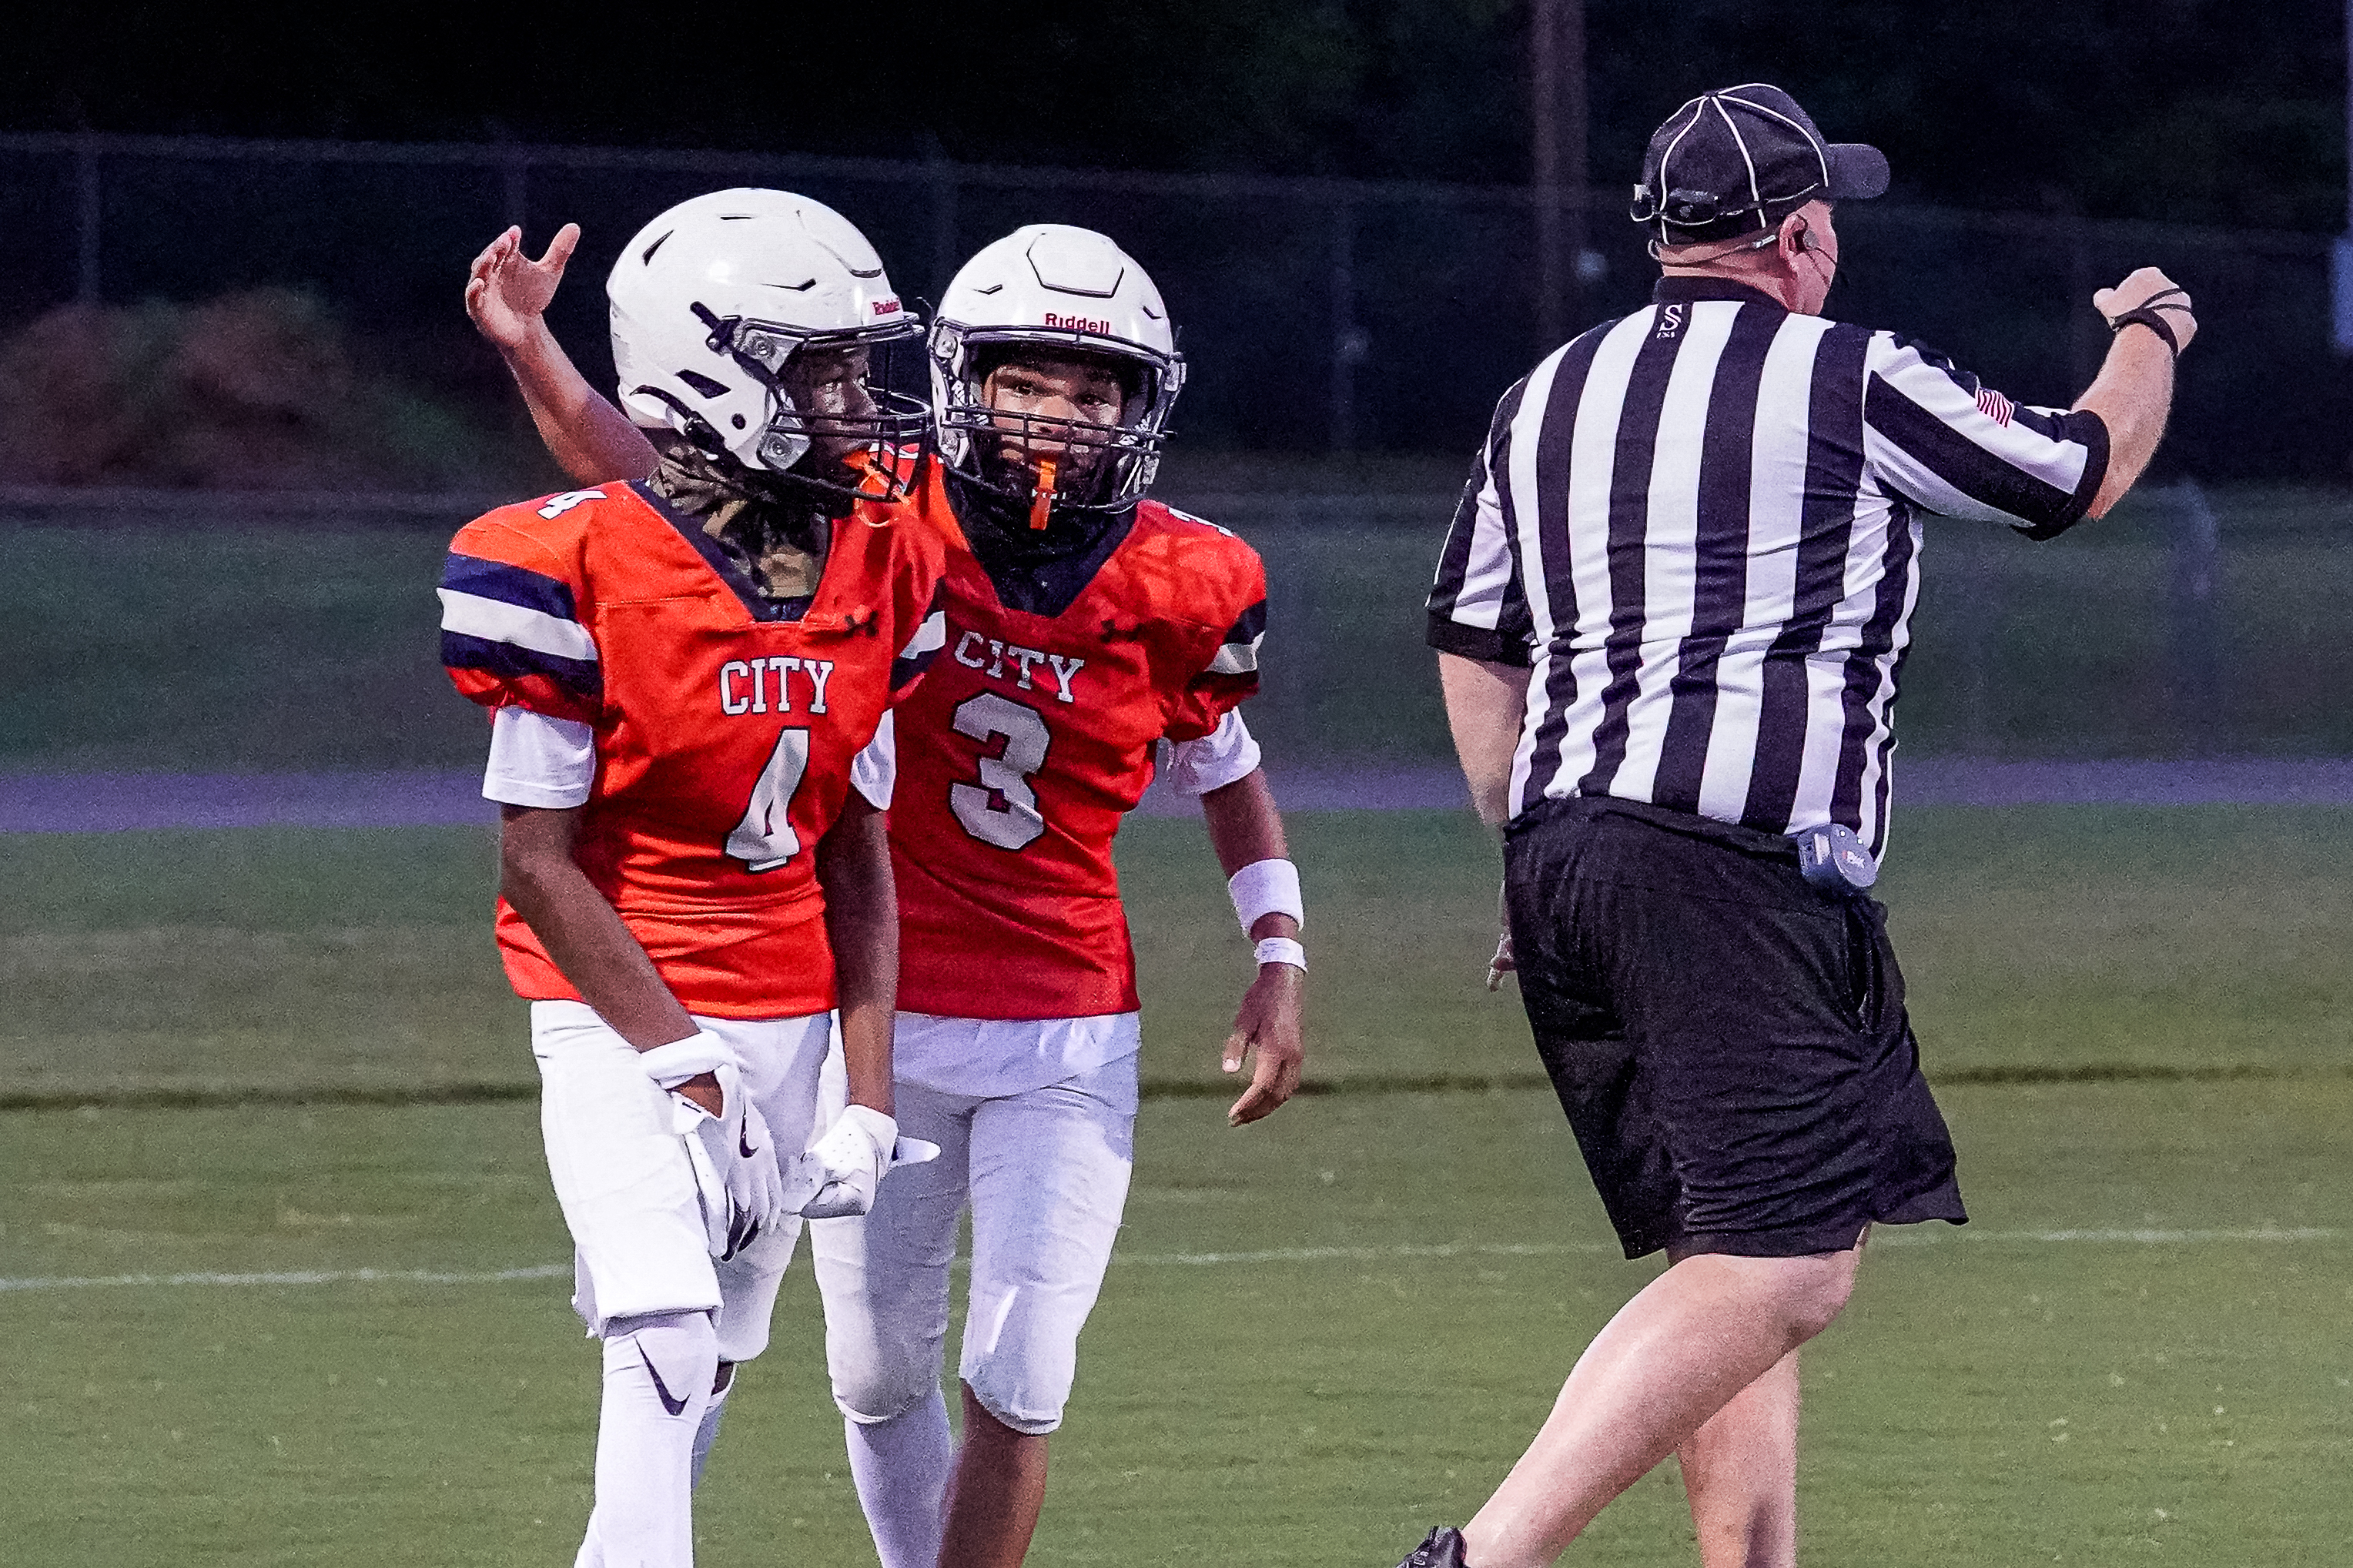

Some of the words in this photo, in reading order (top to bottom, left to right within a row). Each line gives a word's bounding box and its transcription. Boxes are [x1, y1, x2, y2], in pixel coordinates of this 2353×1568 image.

[1045, 313, 1110, 334] Riddell
[720, 656, 834, 716] CITY
[954, 630, 1085, 703] CITY
[725, 727, 810, 871] 4
[949, 692, 1050, 850] 3
